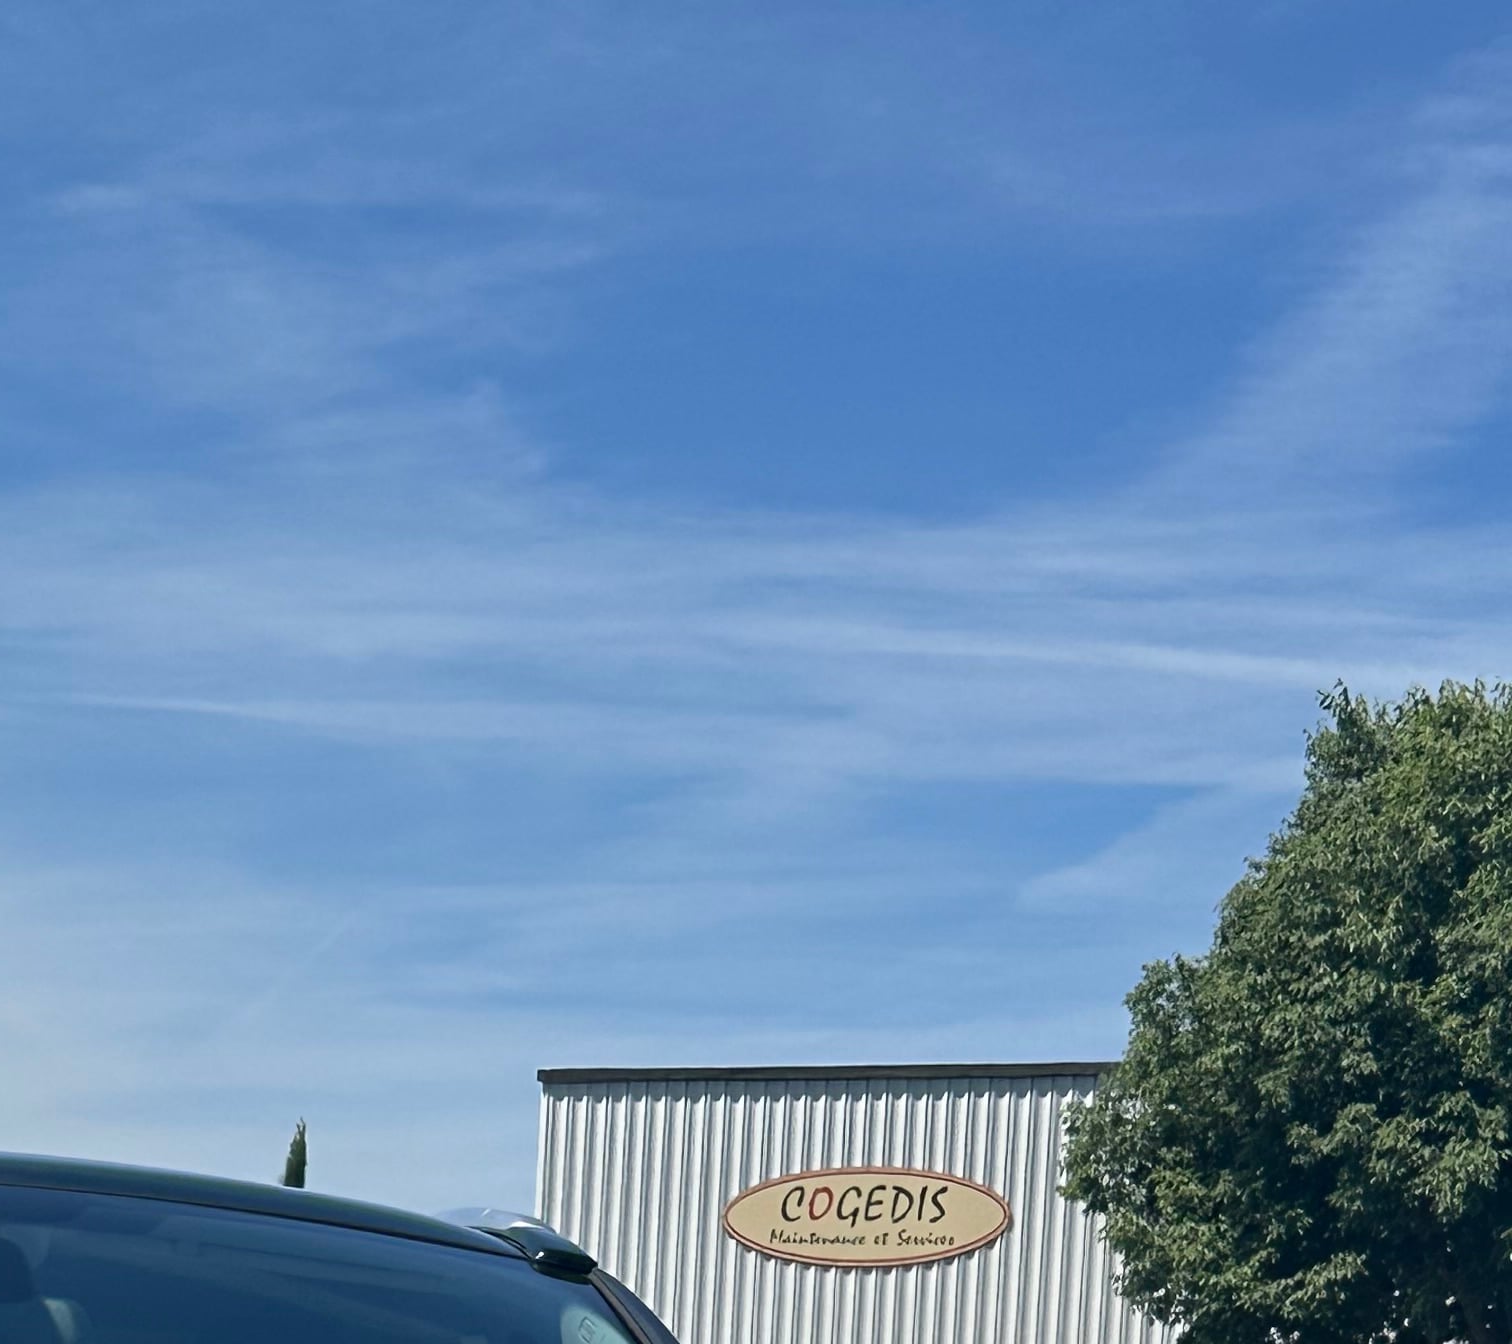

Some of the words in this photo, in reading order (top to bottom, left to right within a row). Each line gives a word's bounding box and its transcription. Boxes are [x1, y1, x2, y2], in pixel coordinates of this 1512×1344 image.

[781, 1185, 949, 1228] COGEDIS
[770, 1228, 866, 1246] Maintenance
[873, 1232, 889, 1246] et
